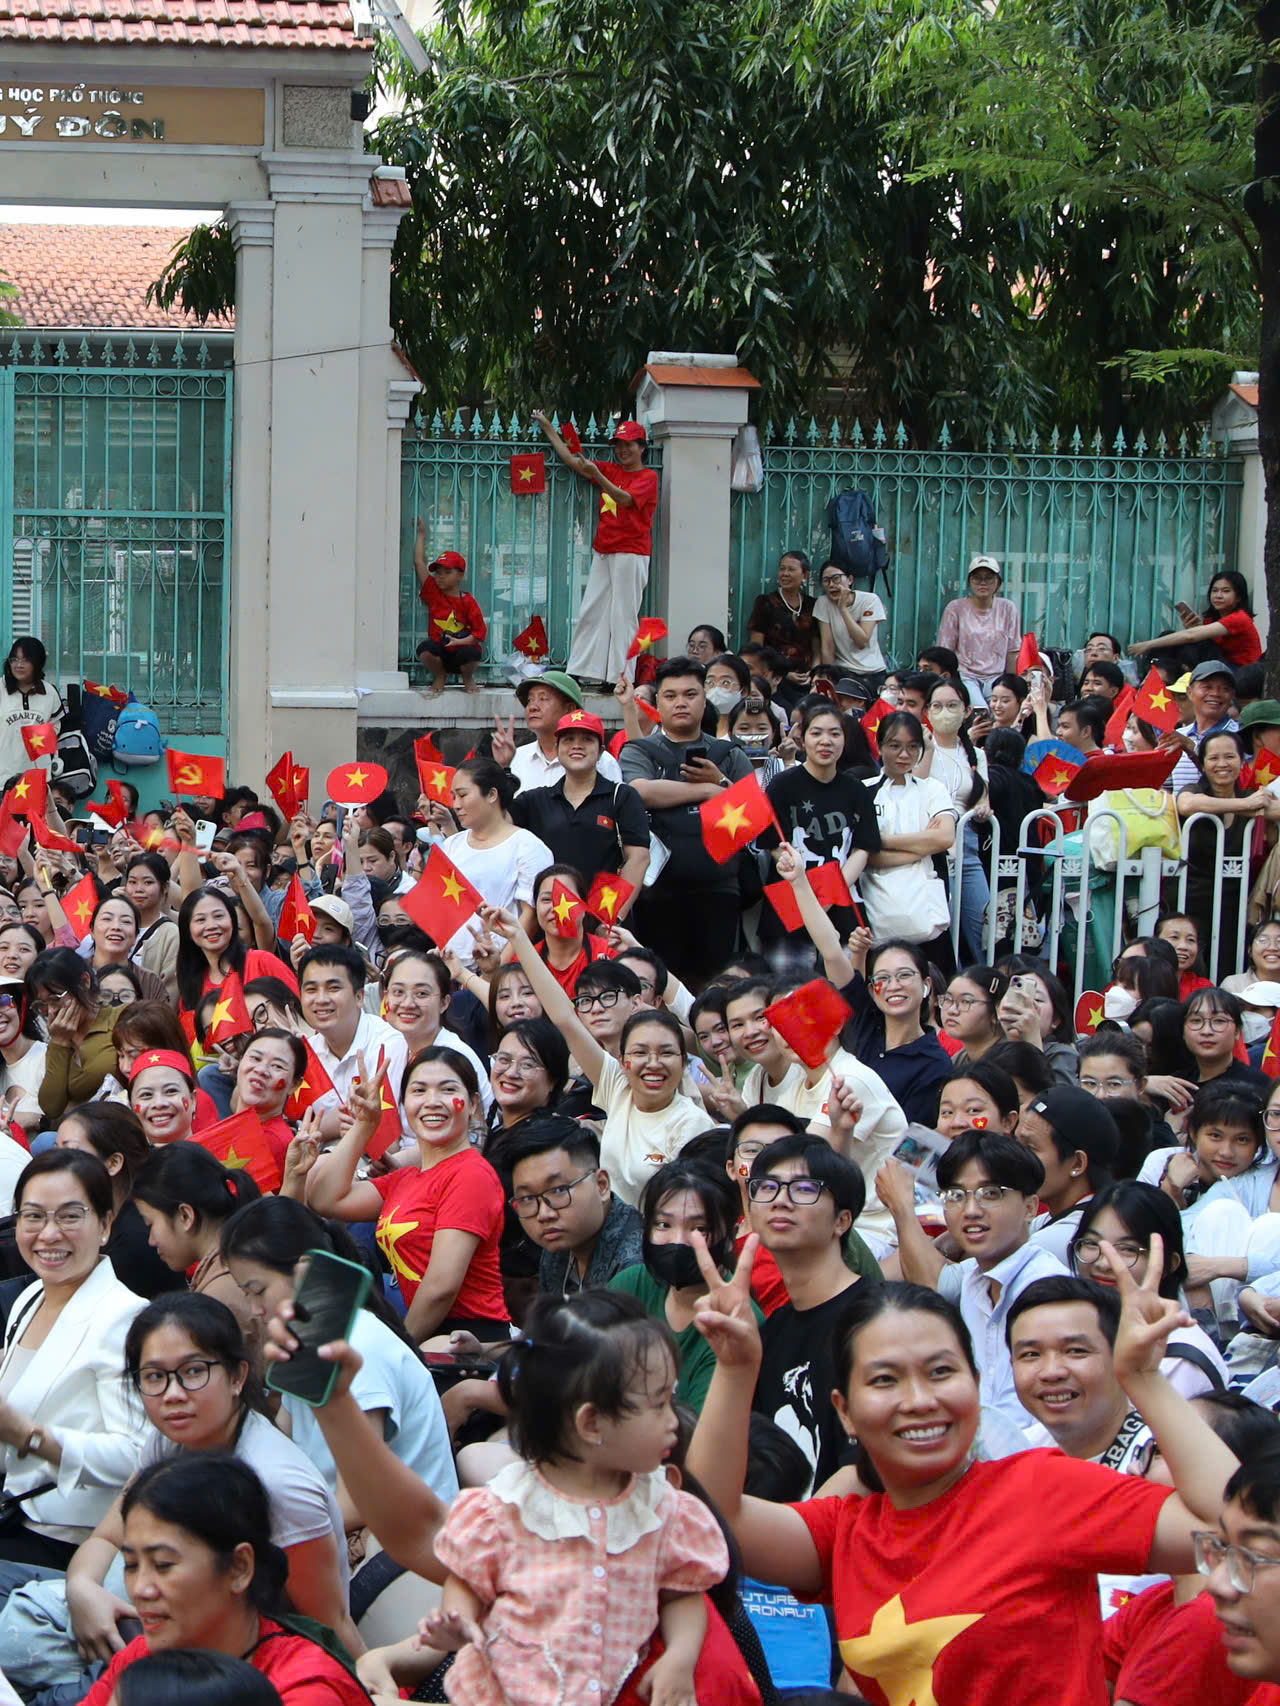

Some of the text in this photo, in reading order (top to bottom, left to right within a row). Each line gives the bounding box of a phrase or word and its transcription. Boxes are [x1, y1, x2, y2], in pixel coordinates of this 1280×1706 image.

[8, 87, 43, 105] HỌC
[49, 83, 84, 102] PHỔ
[55, 110, 165, 139] ĐÔN
